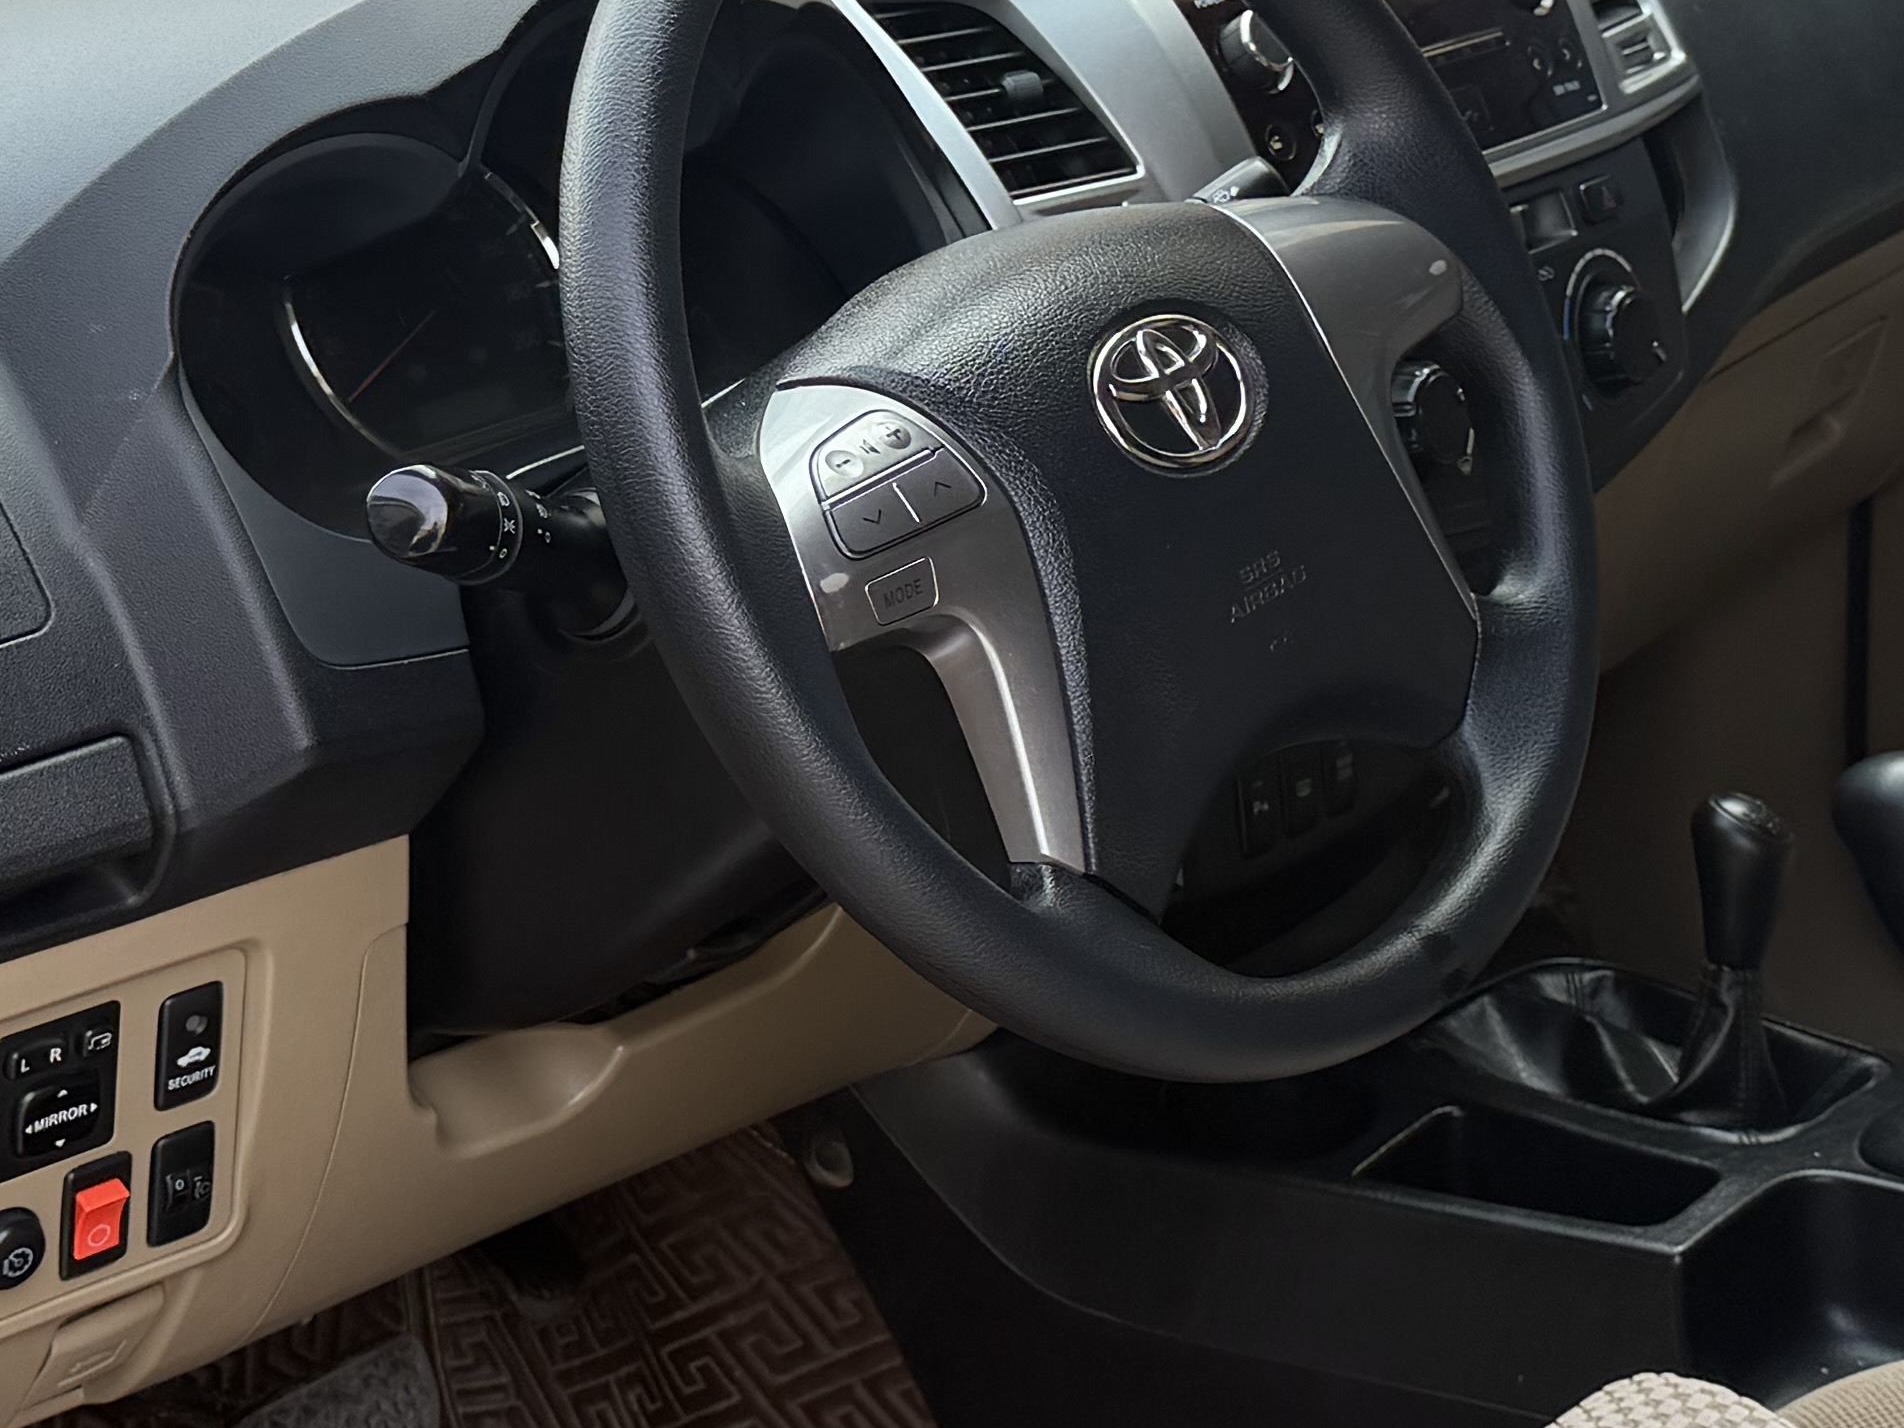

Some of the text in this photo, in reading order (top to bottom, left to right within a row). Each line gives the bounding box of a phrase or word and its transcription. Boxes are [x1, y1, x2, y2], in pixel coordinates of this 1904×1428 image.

[883, 579, 923, 609] MODE
[1231, 565, 1306, 623] AIRBAG
[20, 1047, 62, 1073] L R
[167, 1066, 215, 1090] SECURITY
[35, 1104, 88, 1132] MIRROR
